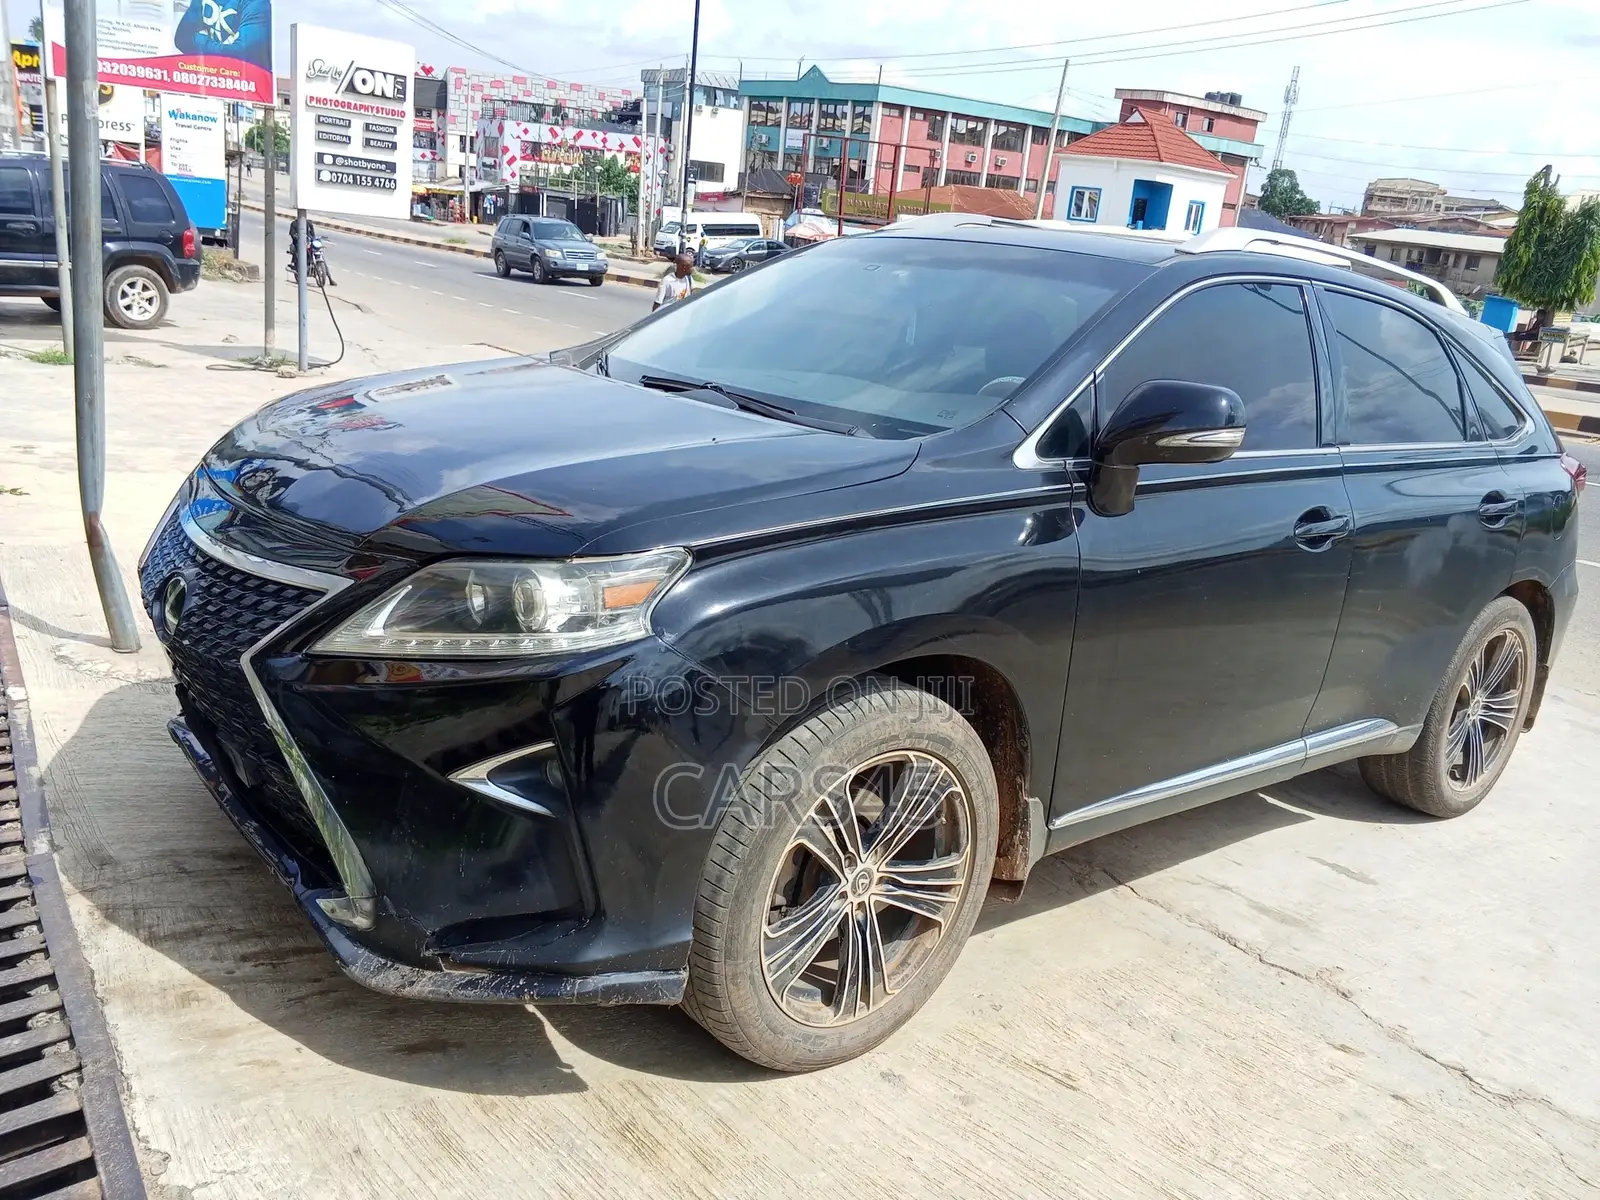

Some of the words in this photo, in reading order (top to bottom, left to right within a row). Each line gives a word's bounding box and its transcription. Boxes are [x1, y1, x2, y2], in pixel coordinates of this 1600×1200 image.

[178, 62, 217, 74] Customer
[219, 67, 241, 77] Care:
[173, 71, 256, 92] 08027338404
[168, 109, 217, 123] Wakanow
[320, 116, 350, 127] PORTRAIT
[368, 124, 394, 134] FASHION
[319, 132, 350, 143] EDITORIAL
[369, 139, 393, 149] BEAUTY
[335, 156, 391, 172] @shotbyone_
[331, 172, 354, 185] 0704
[356, 175, 372, 187] 155
[374, 177, 396, 189] 4766
